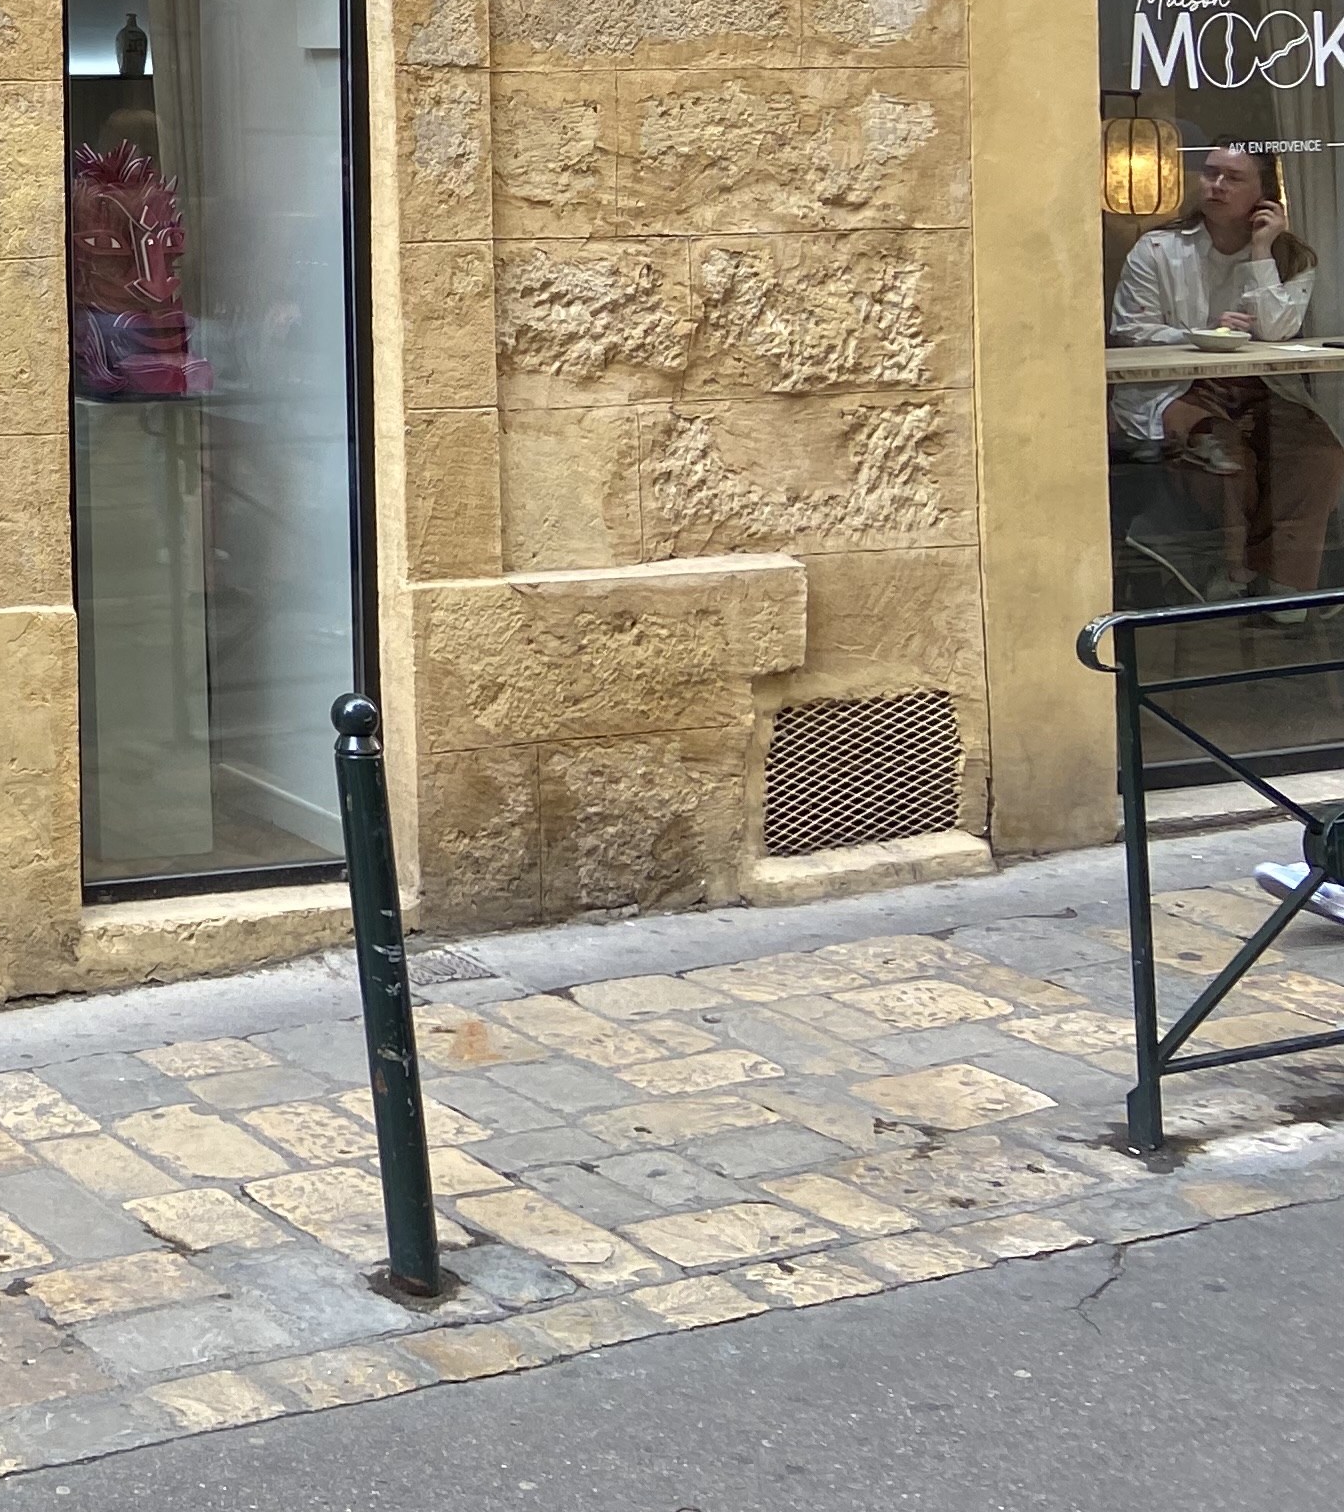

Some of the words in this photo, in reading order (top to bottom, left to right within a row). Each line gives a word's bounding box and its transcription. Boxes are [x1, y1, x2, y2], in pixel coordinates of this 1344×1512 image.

[1228, 142, 1246, 154] AIX
[1248, 141, 1264, 154] EN
[1265, 140, 1323, 152] PROVENCE
